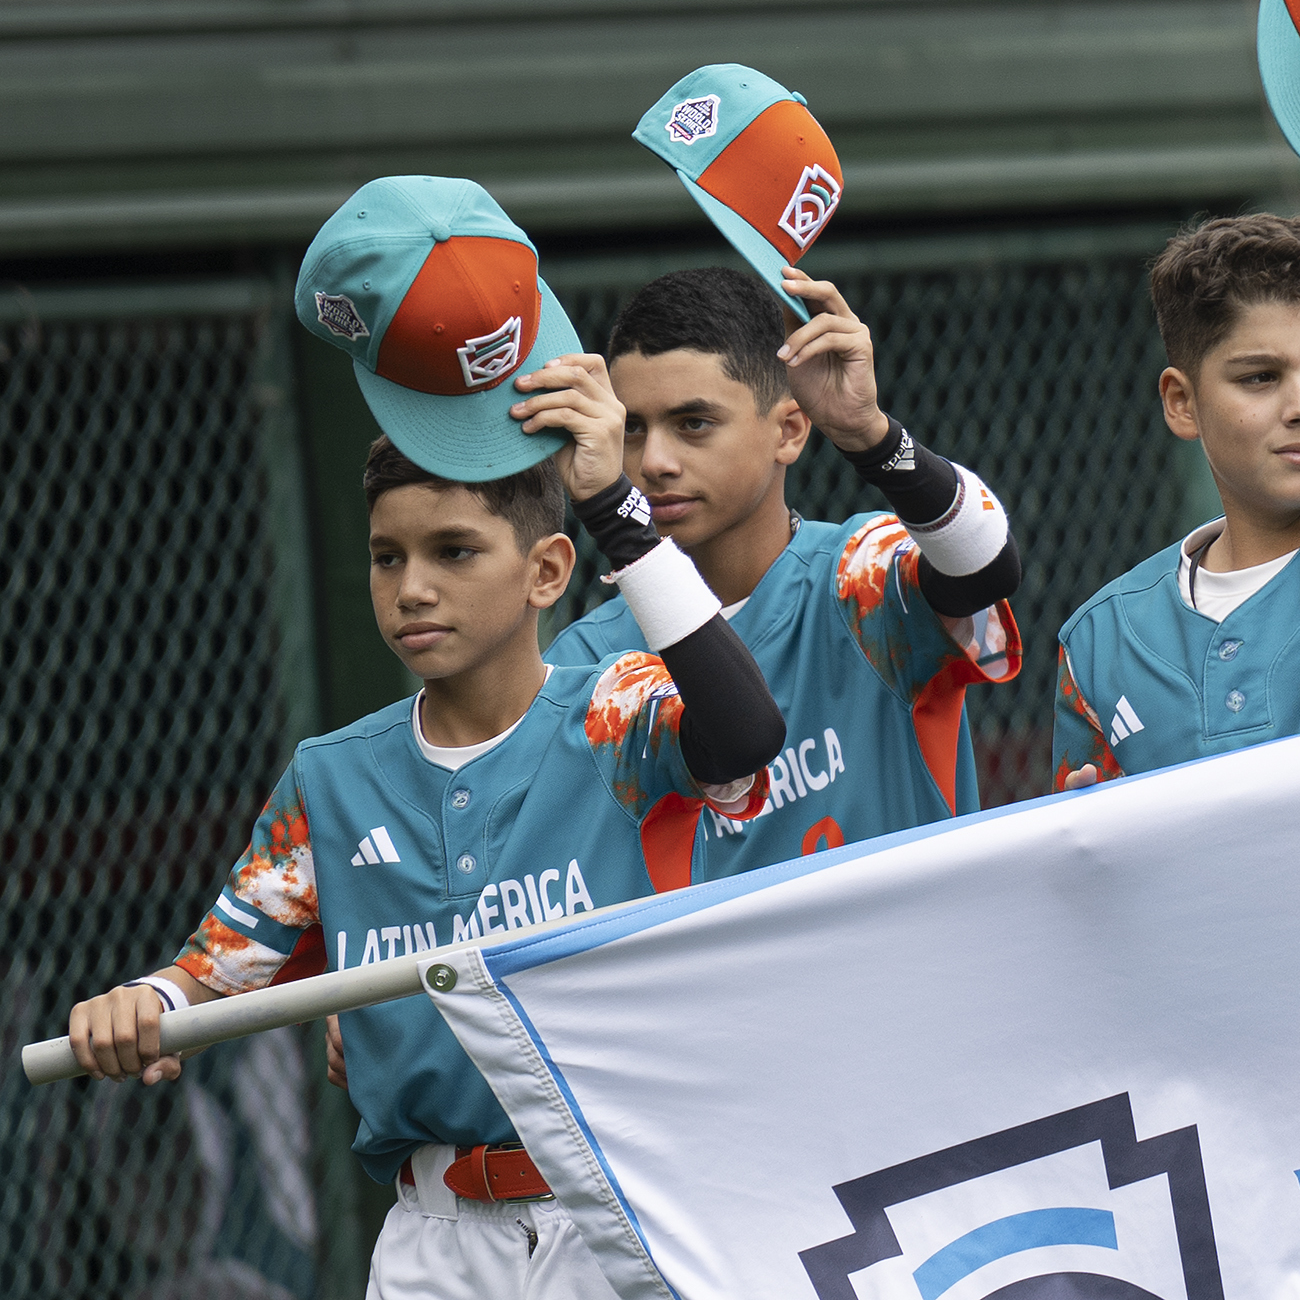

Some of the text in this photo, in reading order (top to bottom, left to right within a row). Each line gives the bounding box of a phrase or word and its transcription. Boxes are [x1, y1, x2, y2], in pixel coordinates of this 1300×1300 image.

[675, 112, 703, 135] SERIES
[681, 104, 713, 129] WORLD
[322, 308, 357, 333] SERIES
[323, 299, 361, 329] WORLD
